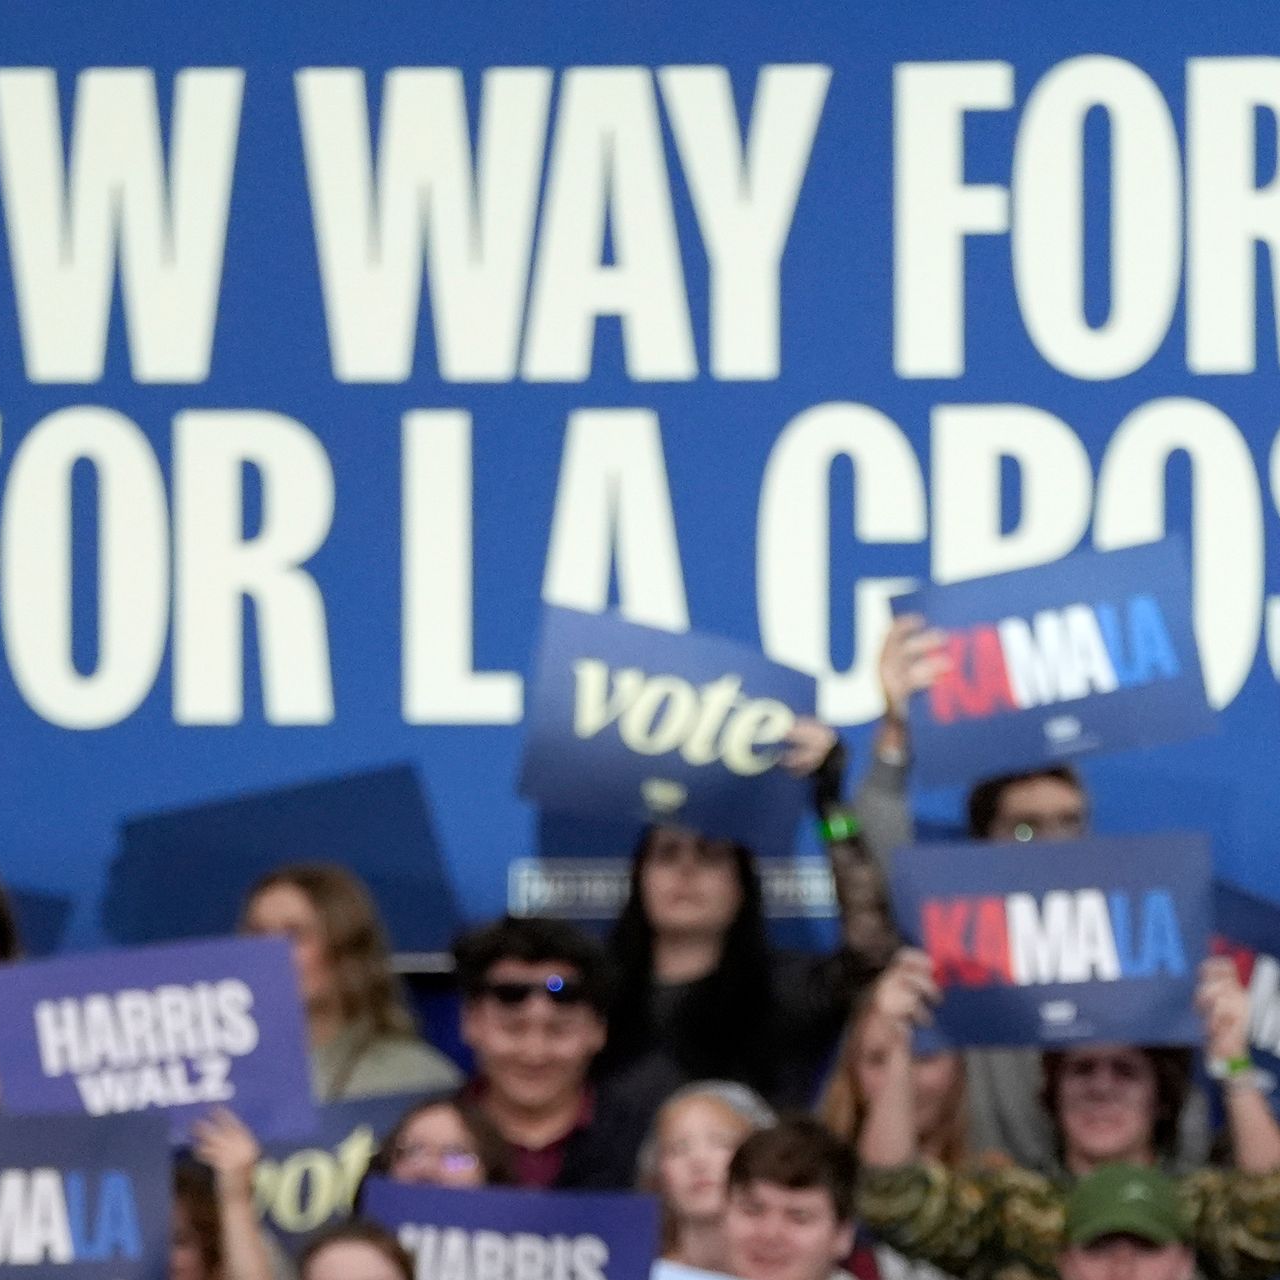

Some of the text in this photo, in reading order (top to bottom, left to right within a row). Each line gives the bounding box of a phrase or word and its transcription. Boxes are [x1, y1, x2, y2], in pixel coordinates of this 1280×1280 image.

[294, 62, 832, 383] WAY
[400, 408, 691, 725] LA
[572, 657, 795, 777] vote
[929, 593, 1182, 725] KAMALA
[923, 889, 1188, 990] KAMALA
[35, 978, 259, 1077] HARRIS
[75, 1056, 236, 1117] WALZ
